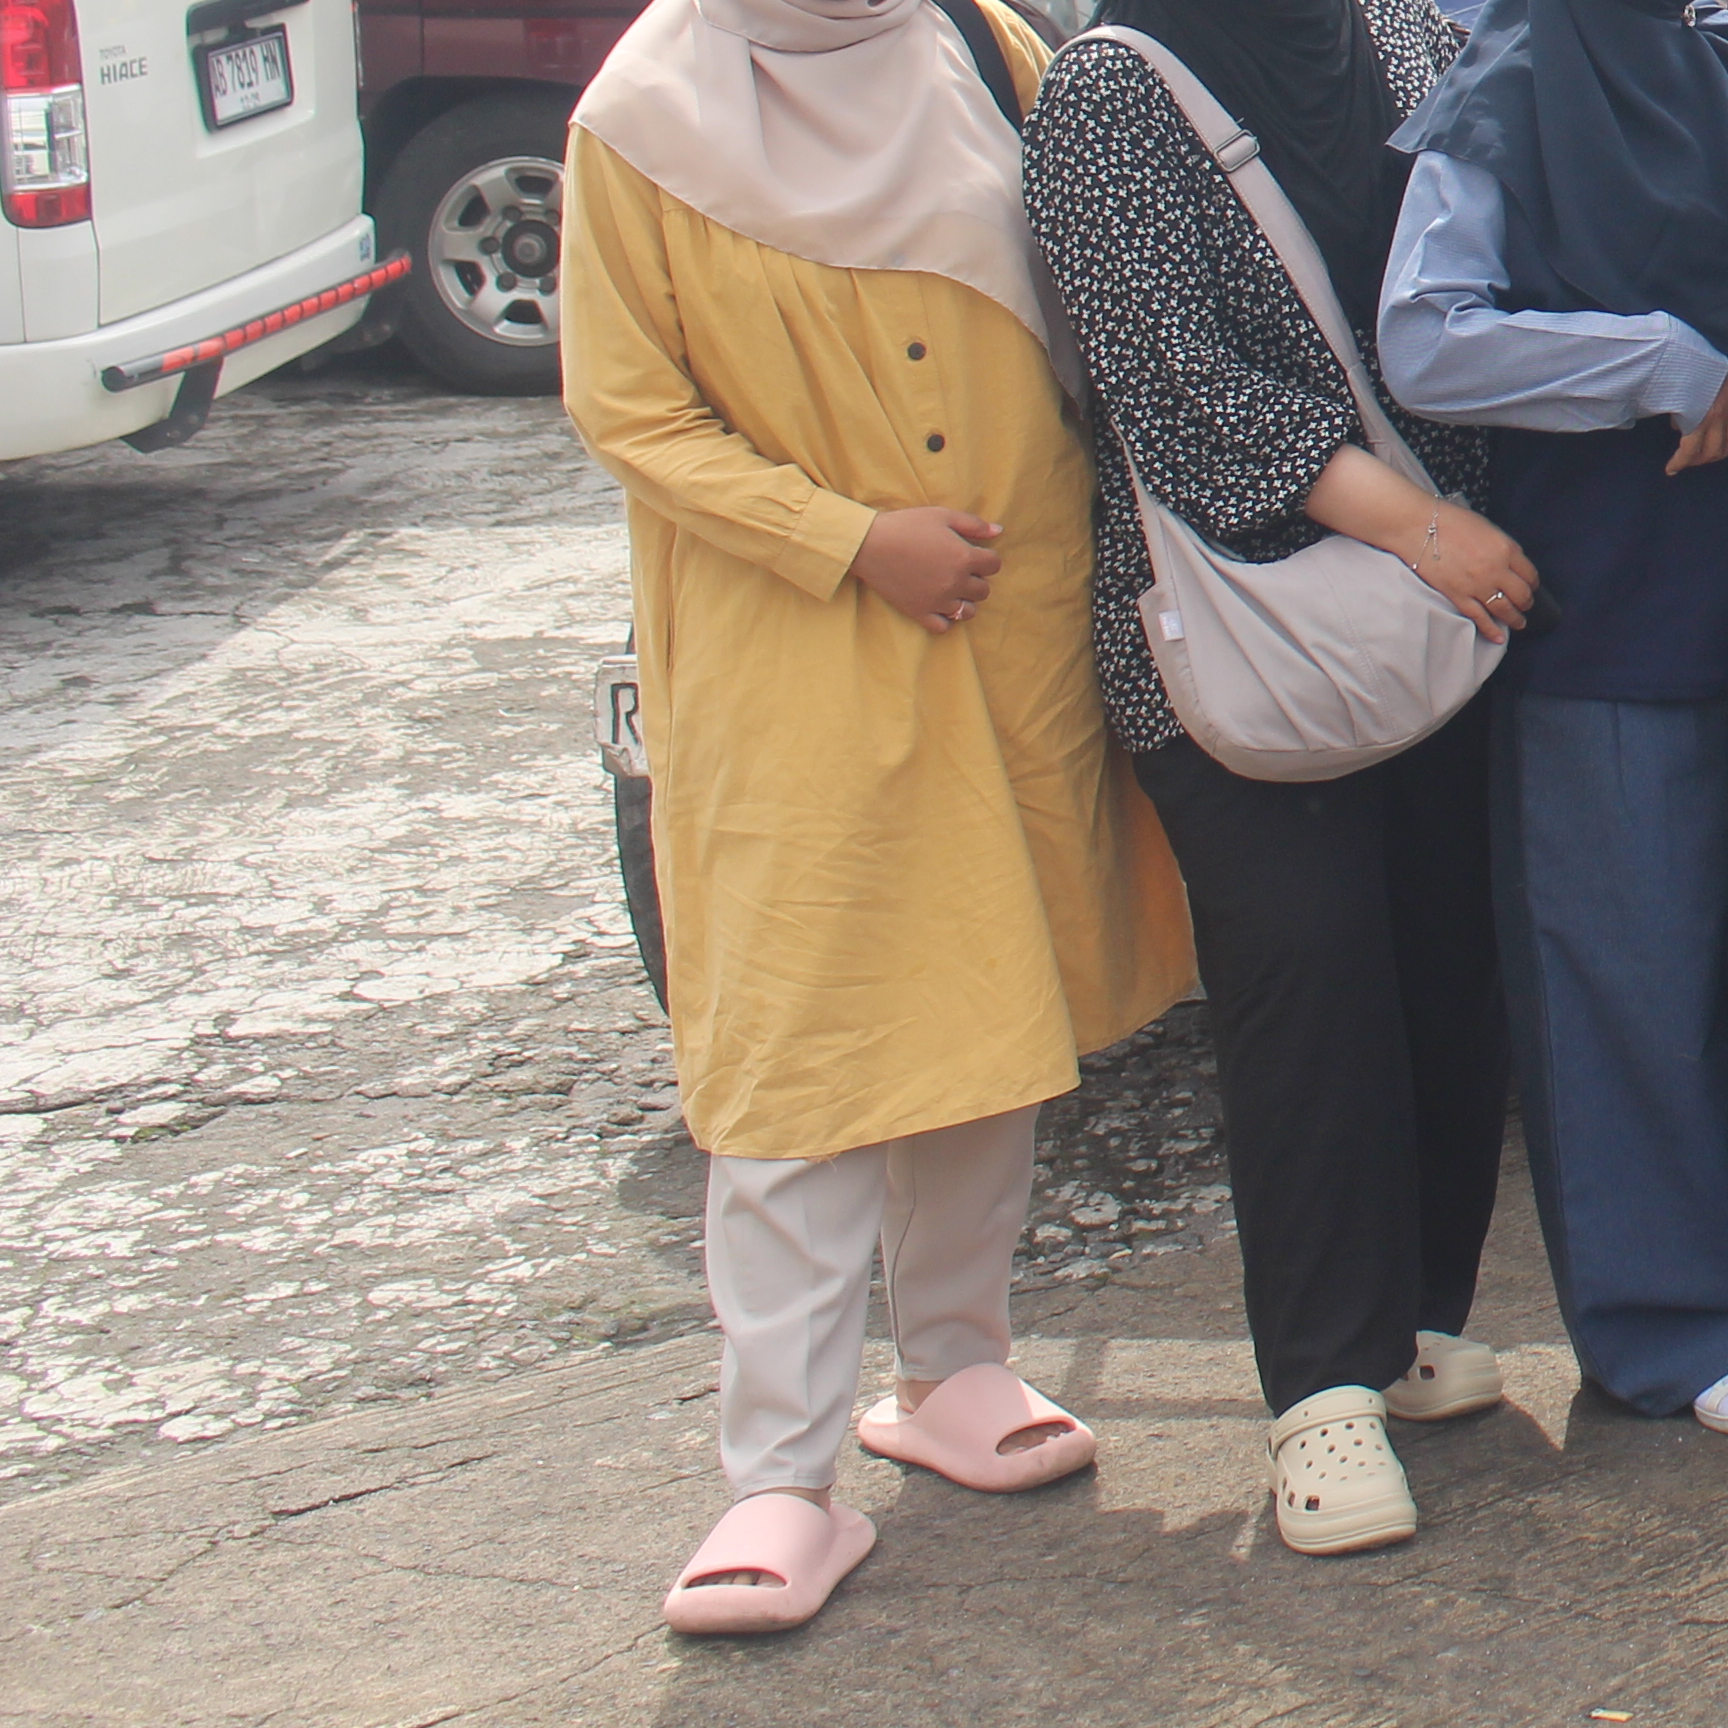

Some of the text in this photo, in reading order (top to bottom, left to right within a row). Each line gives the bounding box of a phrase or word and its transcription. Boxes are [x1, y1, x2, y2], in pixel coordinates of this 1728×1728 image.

[100, 45, 126, 60] TOYOTA
[101, 57, 148, 85] HIACE
[211, 41, 281, 99] AB 7819 HN
[611, 682, 642, 745] R
